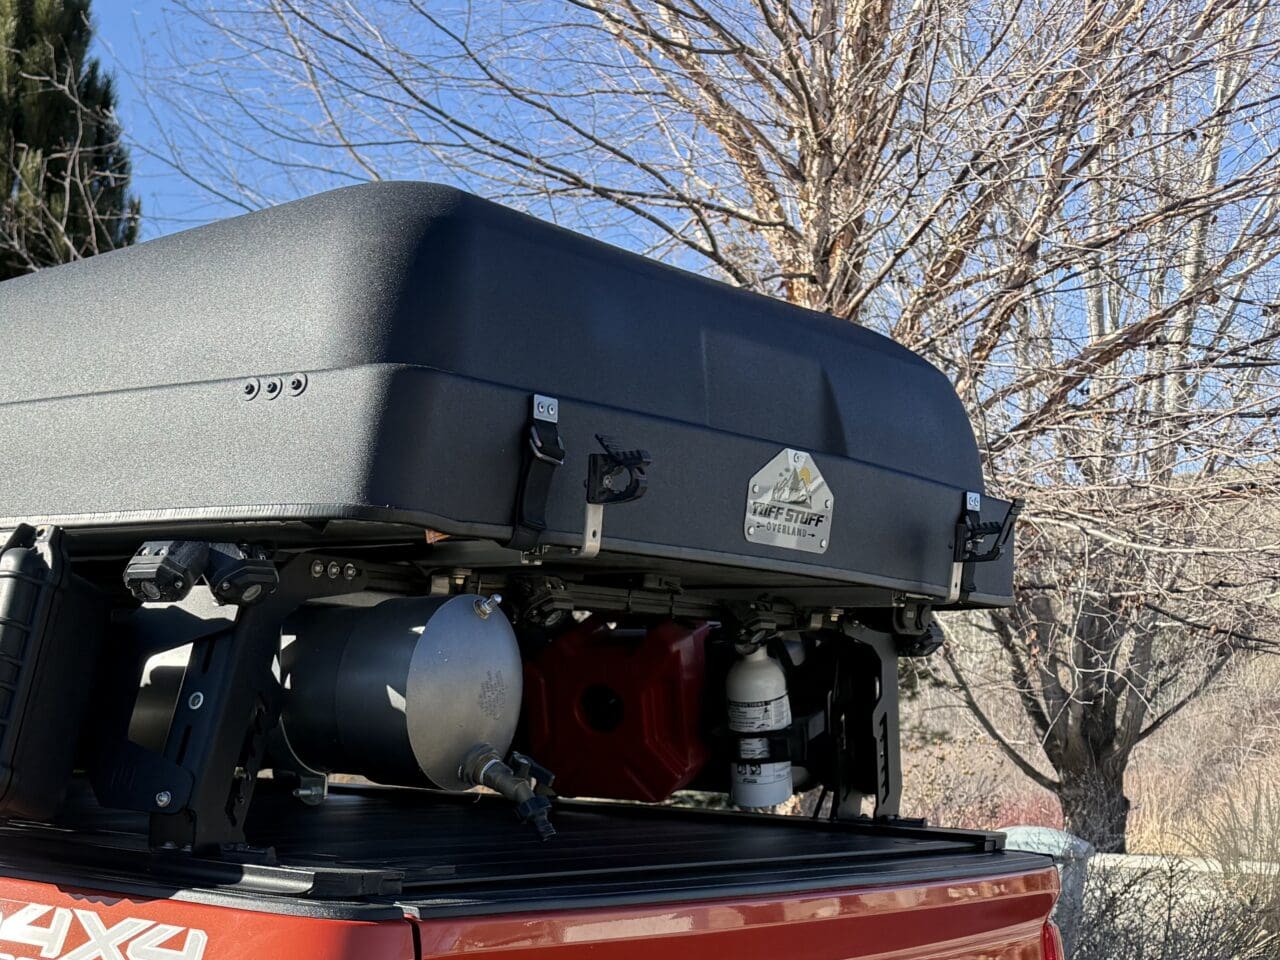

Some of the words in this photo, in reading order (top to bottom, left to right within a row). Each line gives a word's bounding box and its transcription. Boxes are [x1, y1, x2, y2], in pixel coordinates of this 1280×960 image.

[752, 502, 784, 520] TUFF
[785, 508, 825, 527] STUFF
[766, 523, 807, 538] OVERLAND
